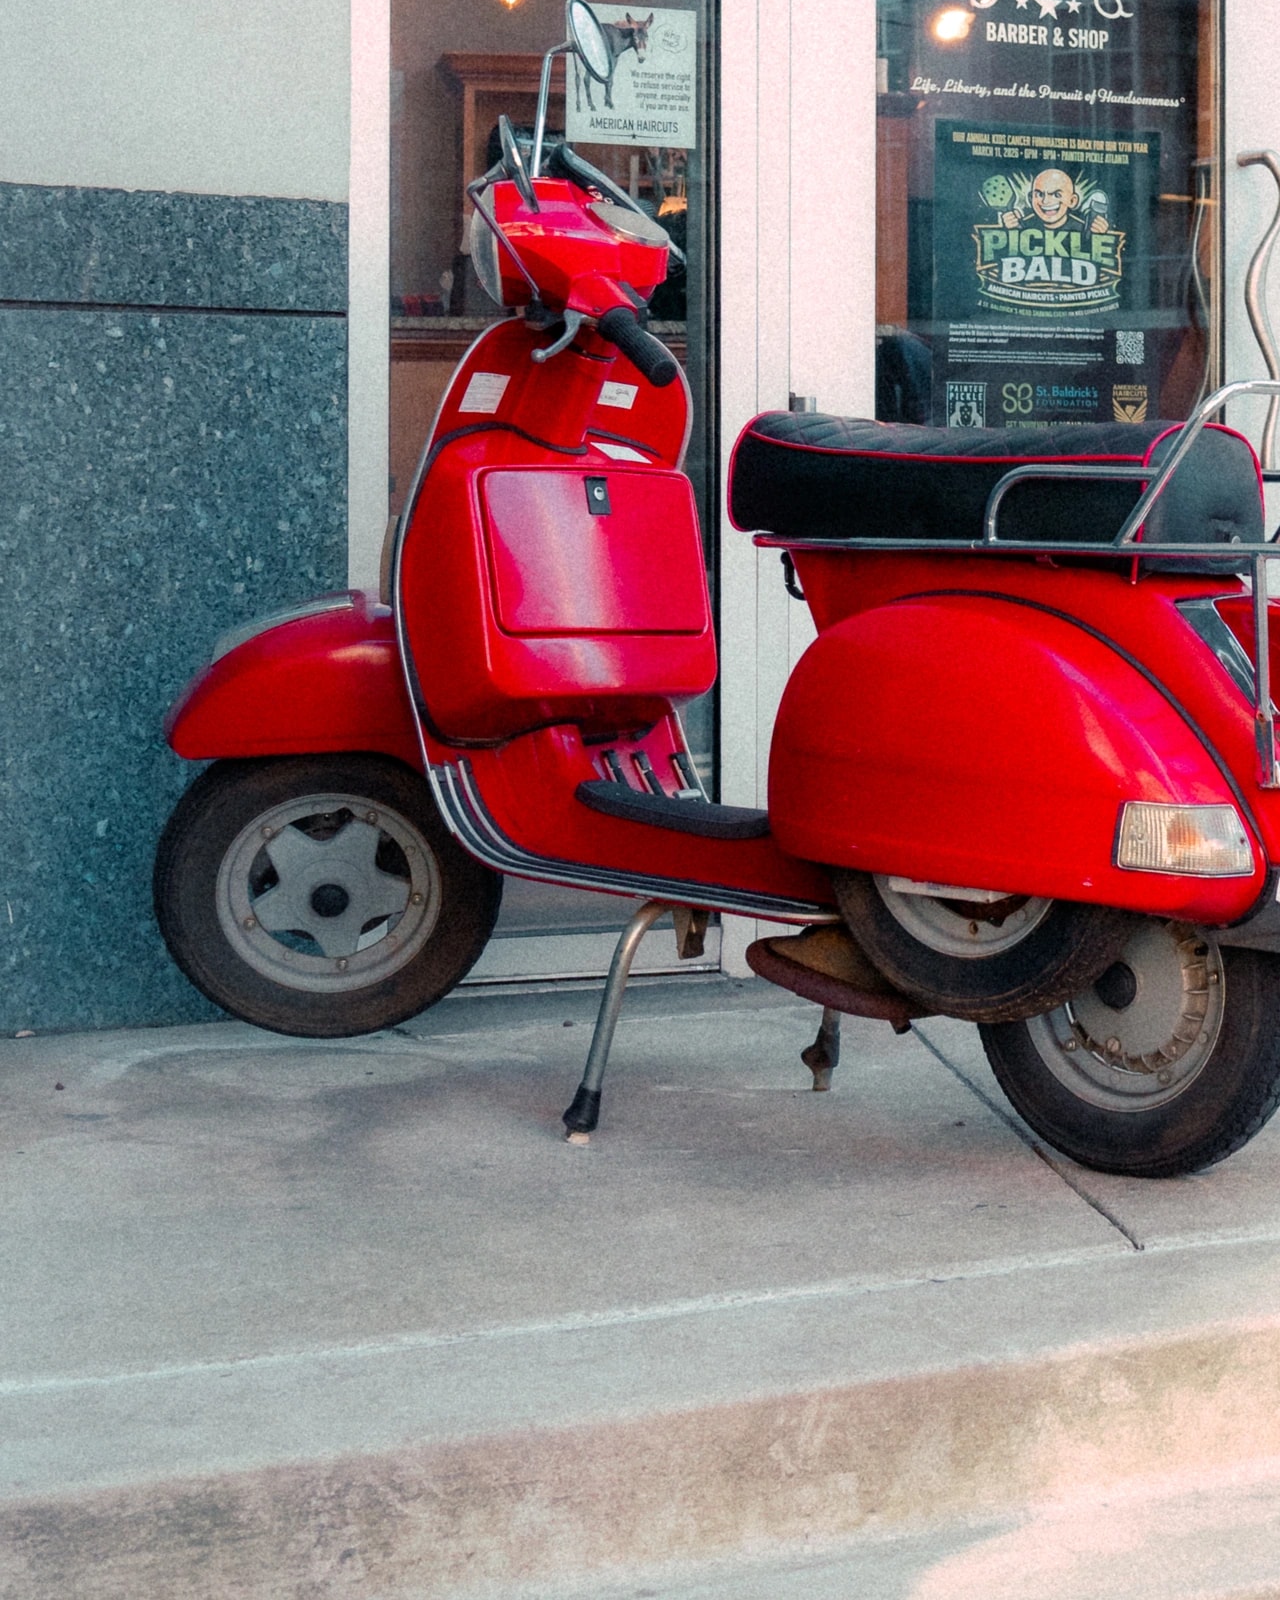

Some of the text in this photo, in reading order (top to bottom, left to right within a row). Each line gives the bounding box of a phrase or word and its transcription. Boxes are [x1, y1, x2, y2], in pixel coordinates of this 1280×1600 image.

[986, 21, 1109, 51] BARBER & SHOP
[665, 72, 675, 81] the
[676, 73, 691, 84] right
[911, 77, 941, 94] Life,
[942, 79, 991, 98] Liberty,
[993, 83, 1017, 97] and
[1018, 84, 1037, 98] the
[1038, 84, 1083, 101] Pursuit
[1084, 88, 1097, 105] of
[589, 117, 679, 134] AMERICAN HAIRCUTS
[980, 227, 1116, 268] PICKLE
[1000, 256, 1097, 287] BALD
[987, 284, 1110, 302] AMERICAN HAIRCUTS PAINTED PICKLE
[949, 384, 983, 393] PAINTED
[1036, 385, 1098, 398] St. Baldrick's
[1113, 384, 1148, 392] AMERICAN
[1113, 390, 1148, 398] HAIRCUTS
[949, 392, 983, 401] PICKLE
[1036, 399, 1098, 408] FOUNDATION
